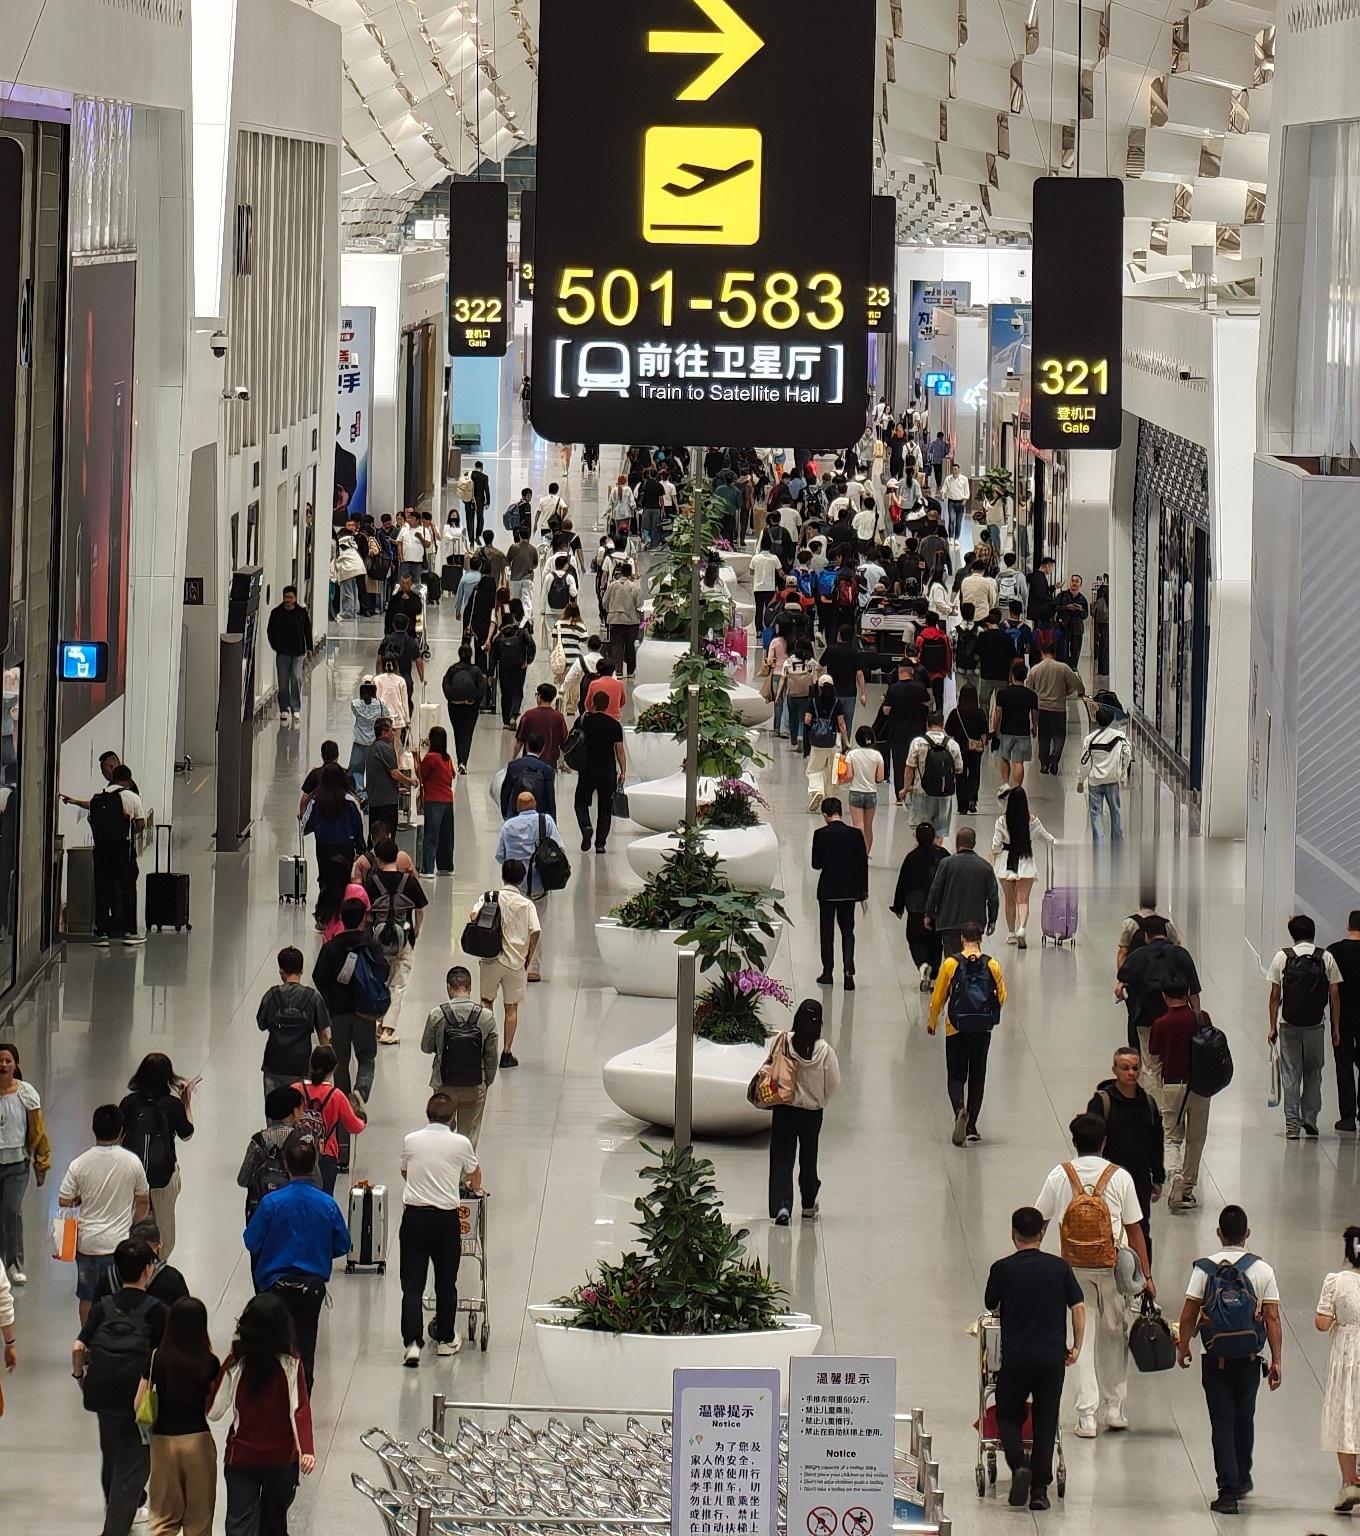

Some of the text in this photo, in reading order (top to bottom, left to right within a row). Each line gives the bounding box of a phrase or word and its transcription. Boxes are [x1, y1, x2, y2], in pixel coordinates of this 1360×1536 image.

[557, 268, 845, 330] 501-583
[454, 299, 502, 323] 322
[637, 343, 821, 381] 前往卫星厅
[1040, 359, 1108, 395] 321
[638, 383, 820, 403] Train to Satellite Hall
[1057, 407, 1096, 422] 登机口
[1062, 422, 1090, 434] Gate
[816, 1372, 870, 1385] 温馨提示
[698, 1404, 755, 1418] 温馨提示
[712, 1420, 741, 1428] Notice
[714, 1441, 761, 1453] 为了您及
[826, 1449, 857, 1458] Notice
[689, 1495, 761, 1507] 勿让儿童乘坐
[690, 1521, 760, 1533] 在自动扶梯上
